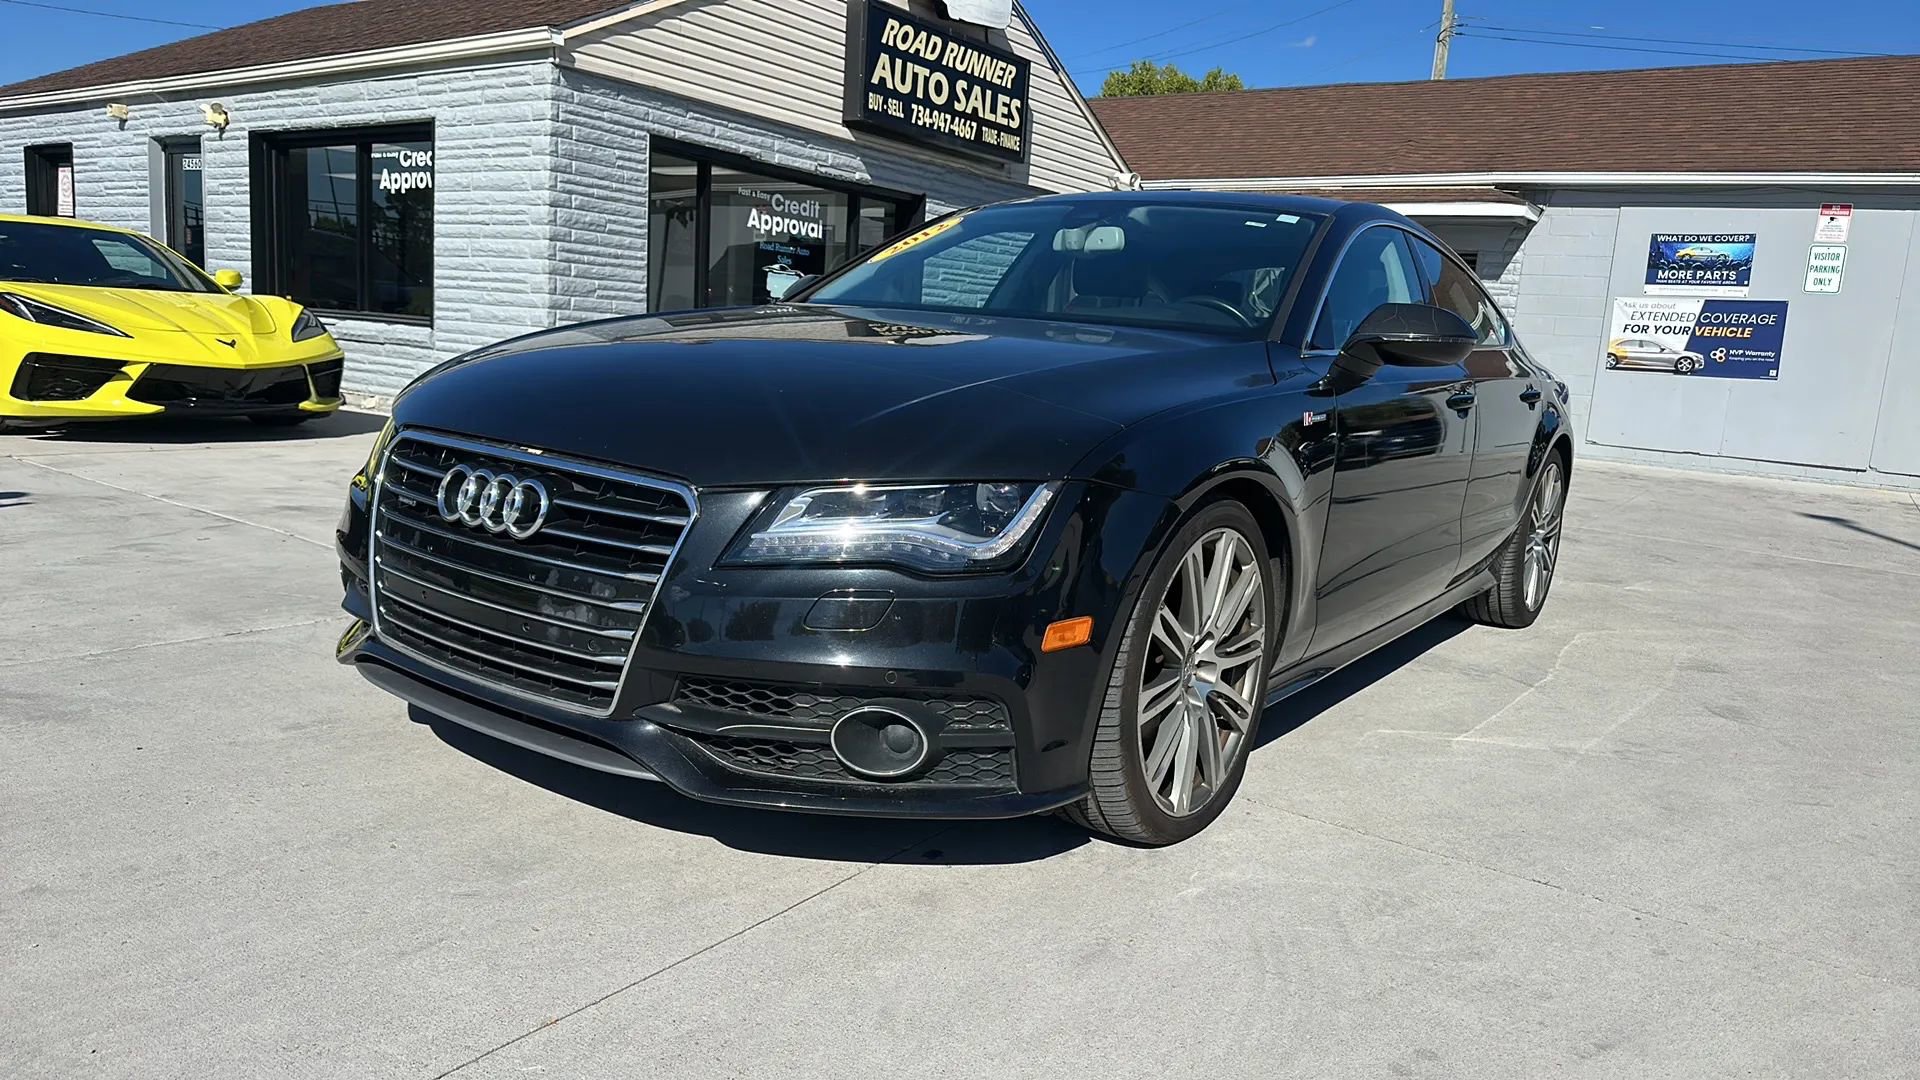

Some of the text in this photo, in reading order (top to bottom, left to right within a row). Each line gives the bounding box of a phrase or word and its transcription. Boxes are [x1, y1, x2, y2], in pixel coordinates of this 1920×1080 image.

[881, 18, 1017, 89] ROAD RUNNER
[871, 52, 1021, 129] AUTO SALES
[869, 91, 884, 112] BUY
[887, 98, 904, 118] SELL
[911, 103, 977, 141] 734-947-4667
[982, 126, 998, 145] TRADE
[738, 187, 751, 196] Fast
[757, 191, 771, 201] Easy
[771, 193, 820, 218] Credit
[747, 208, 823, 239] Approval
[1657, 234, 1682, 242] WHAT
[1814, 252, 1840, 261] VISITOR
[1657, 270, 1737, 280] MORE PARTS
[1809, 264, 1840, 274] PARKING
[1813, 277, 1832, 286] ONLY
[1630, 311, 1778, 325] EXTENDED COVERAGE
[1622, 324, 1753, 338] FOR YOUR VEHICLE
